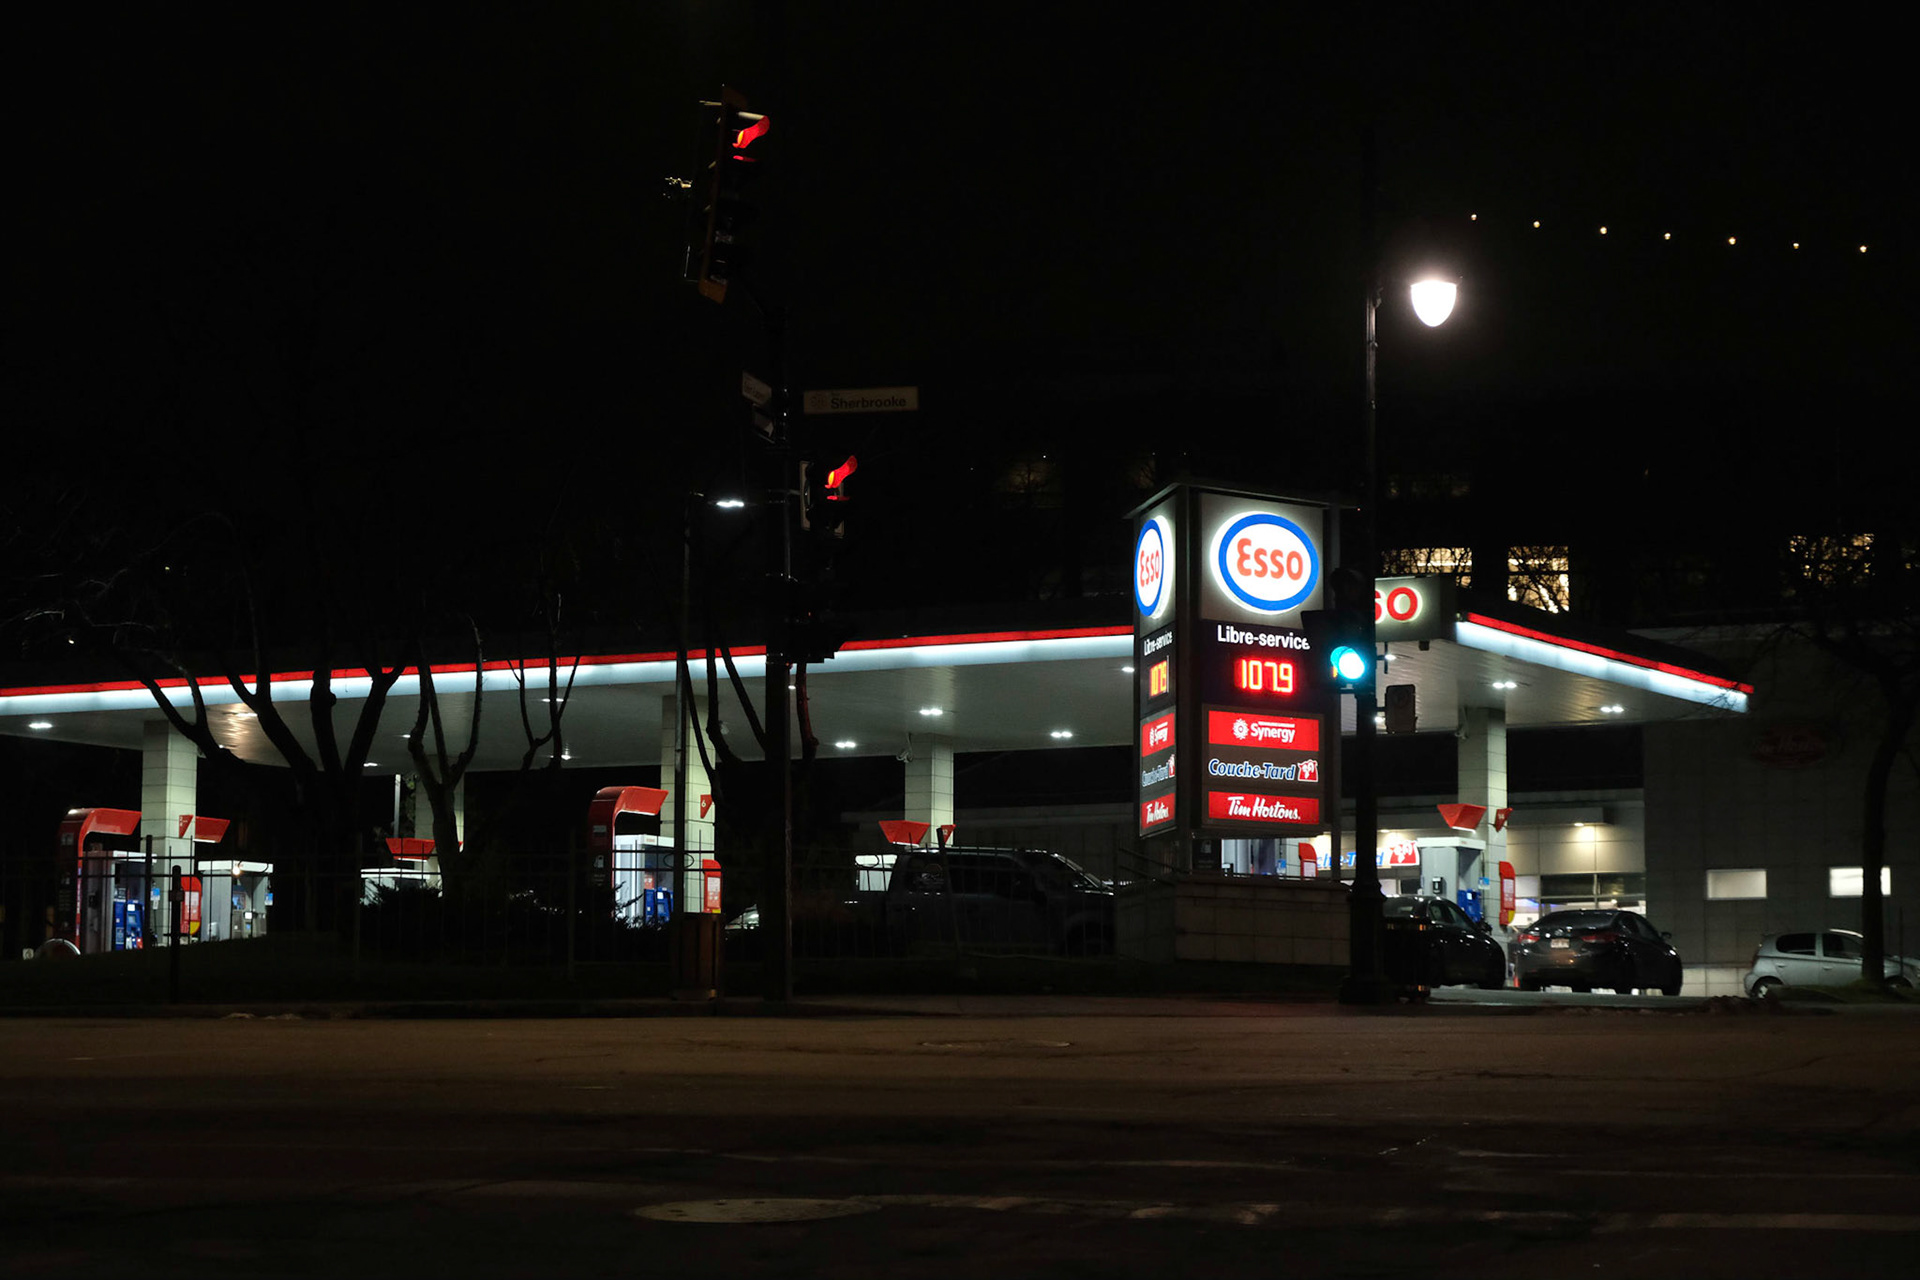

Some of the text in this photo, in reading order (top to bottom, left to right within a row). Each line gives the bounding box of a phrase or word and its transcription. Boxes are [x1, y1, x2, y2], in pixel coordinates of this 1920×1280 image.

[831, 395, 907, 411] Sherbrooke
[1217, 624, 1311, 650] Libre-service
[1250, 722, 1296, 743] Synergy
[1208, 758, 1296, 781] Couche-Tard
[1227, 796, 1251, 816] Tim
